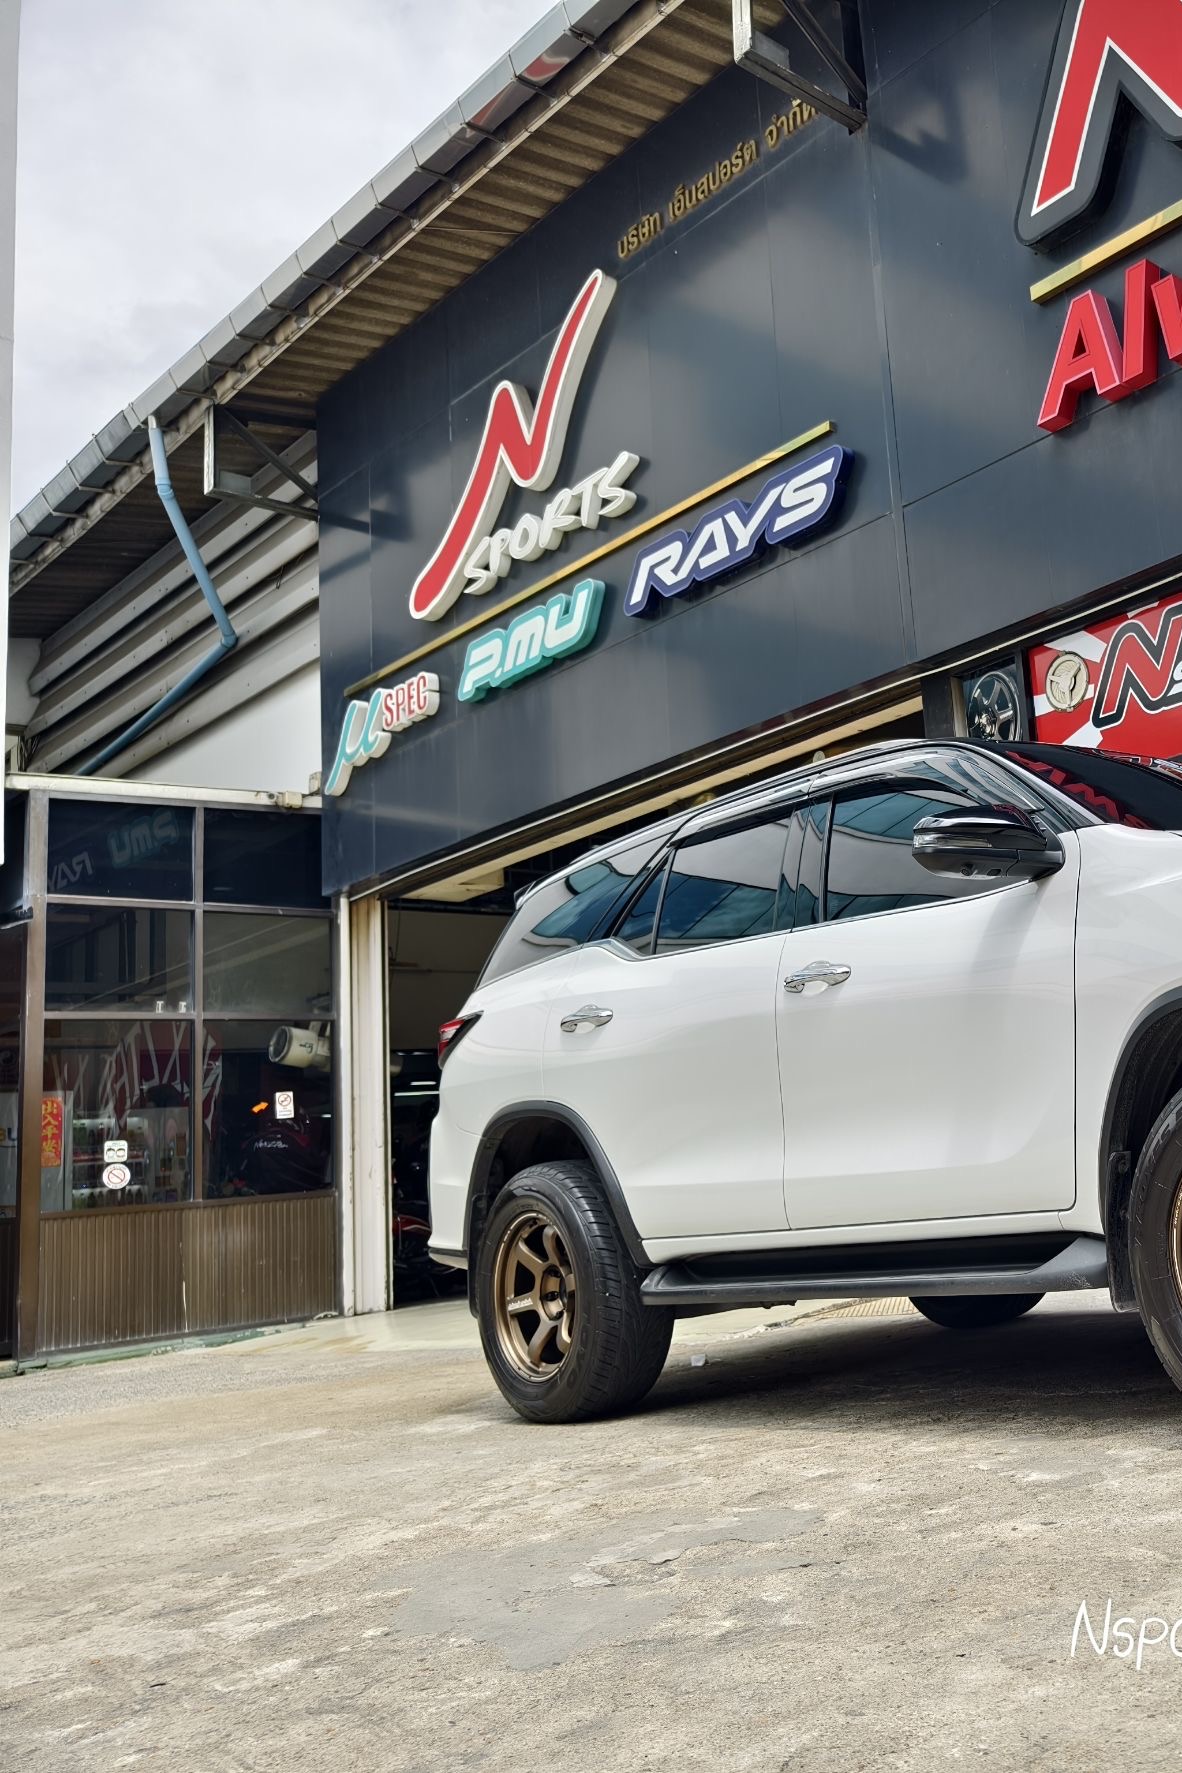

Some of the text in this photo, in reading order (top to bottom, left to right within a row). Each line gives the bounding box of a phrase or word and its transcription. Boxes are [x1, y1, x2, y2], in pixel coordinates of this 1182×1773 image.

[617, 212, 664, 260] บริษัท
[667, 139, 760, 223] เอ็นสปอร์ต
[628, 450, 842, 609] RAYS
